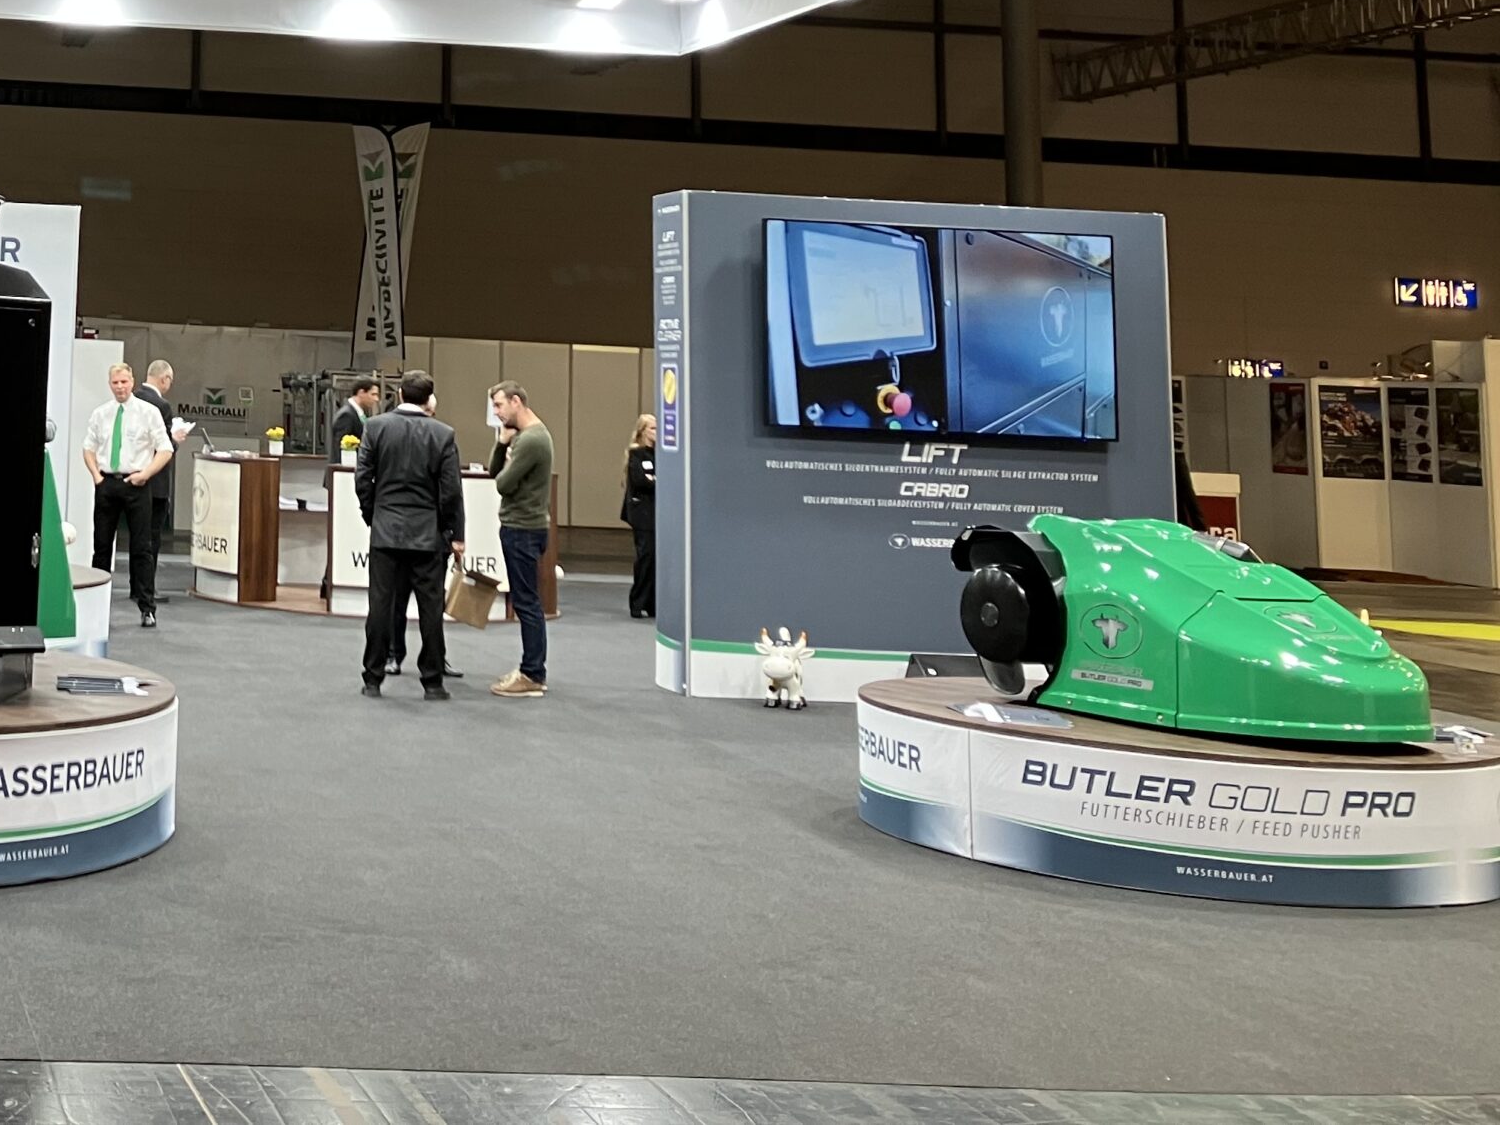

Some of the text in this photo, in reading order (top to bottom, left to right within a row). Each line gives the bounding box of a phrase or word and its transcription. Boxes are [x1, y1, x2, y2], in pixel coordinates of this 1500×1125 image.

[901, 441, 968, 464] LIFT
[766, 460, 842, 471] VOLLAUTOMATISCHES
[935, 466, 956, 475] FULLY
[958, 468, 999, 478] AUTOMATIC
[1071, 473, 1099, 483] SYSTEM
[900, 481, 970, 498] CABRIO
[803, 496, 876, 507] VOLLAUTOMATISCHES
[973, 502, 1011, 513] AUTOMATIC
[1013, 504, 1035, 513] COVER
[1022, 759, 1416, 818] BUTLER GOLD PRO
[1080, 801, 1229, 832] FUTTERSCHIEBER
[1252, 820, 1292, 837] FEED
[1300, 823, 1362, 840] PUSHER
[1176, 866, 1275, 883] WASSERBAUER.AT
